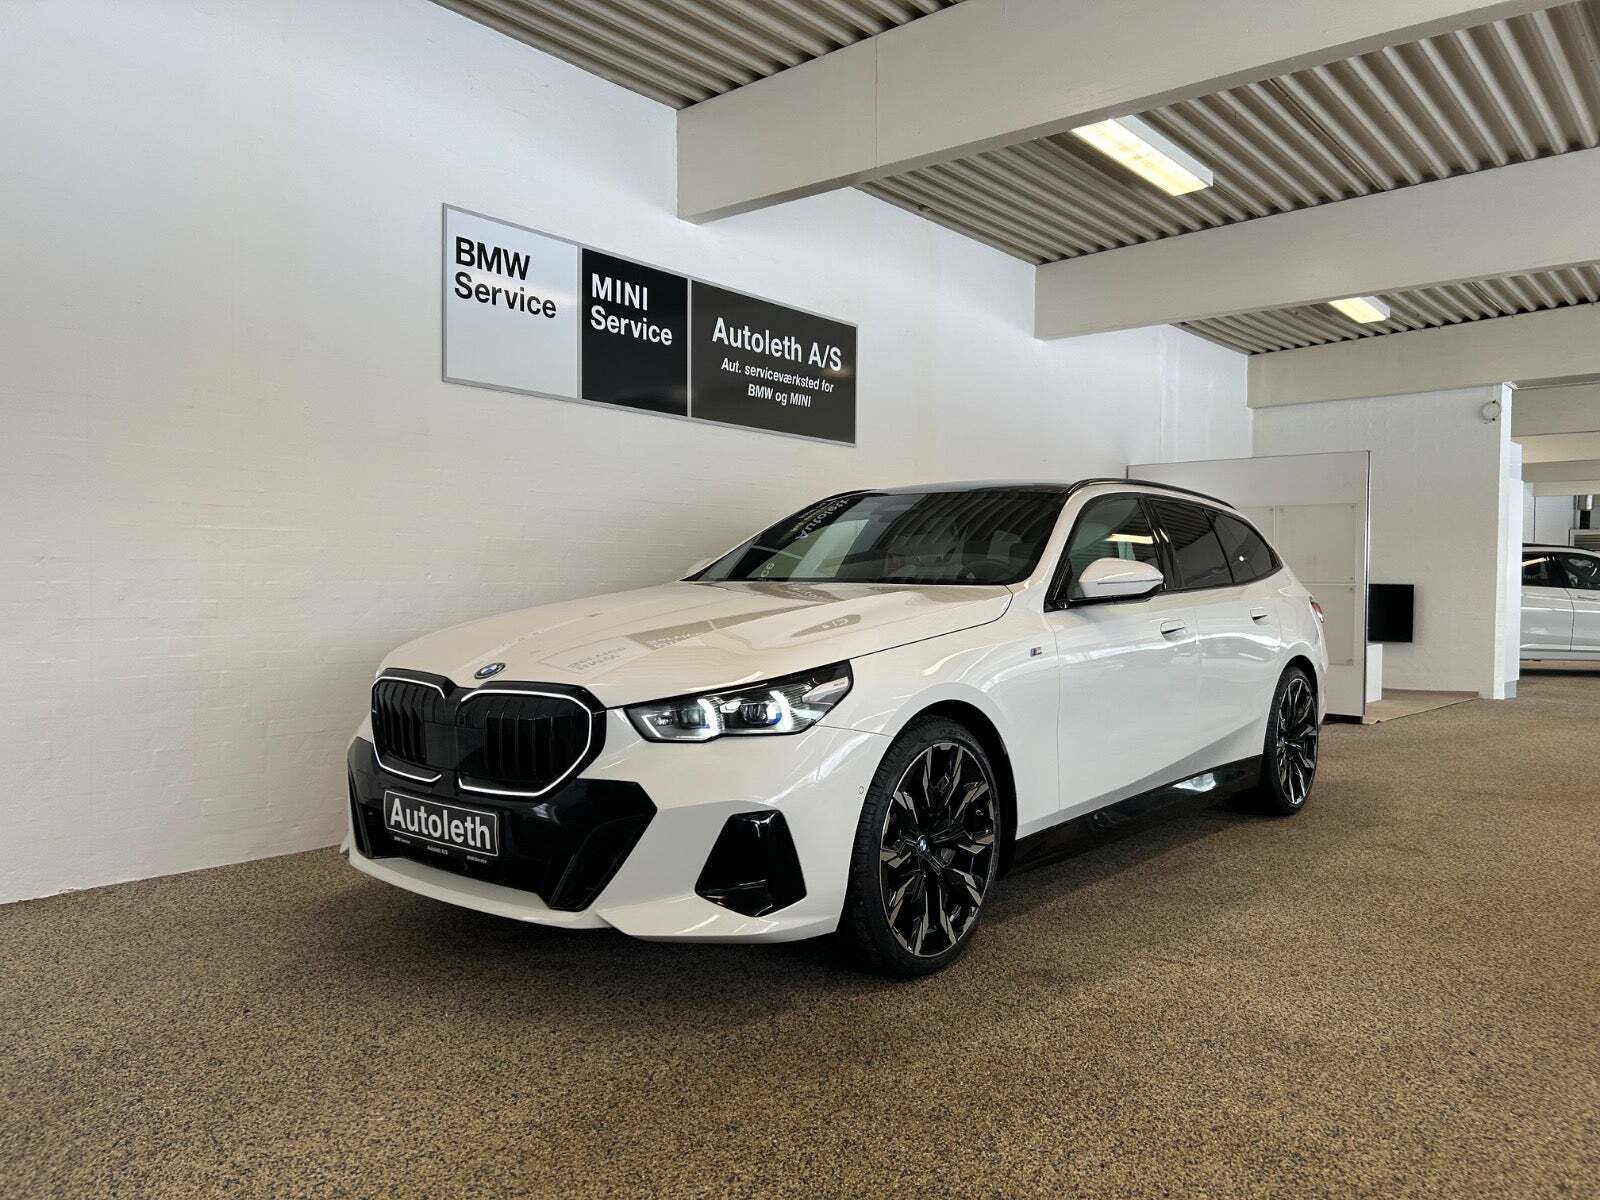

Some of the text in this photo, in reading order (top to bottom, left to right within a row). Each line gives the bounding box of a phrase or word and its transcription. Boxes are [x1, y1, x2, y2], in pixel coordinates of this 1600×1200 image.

[455, 235, 531, 281] BMW
[454, 271, 557, 319] Service
[591, 272, 648, 311] MINI
[590, 304, 673, 346] Service
[711, 316, 842, 372] Autoleth A/S
[721, 357, 834, 393] Aut. serviceværksted for
[748, 383, 812, 408] BMW og MINI
[390, 797, 491, 850] Autoleth
